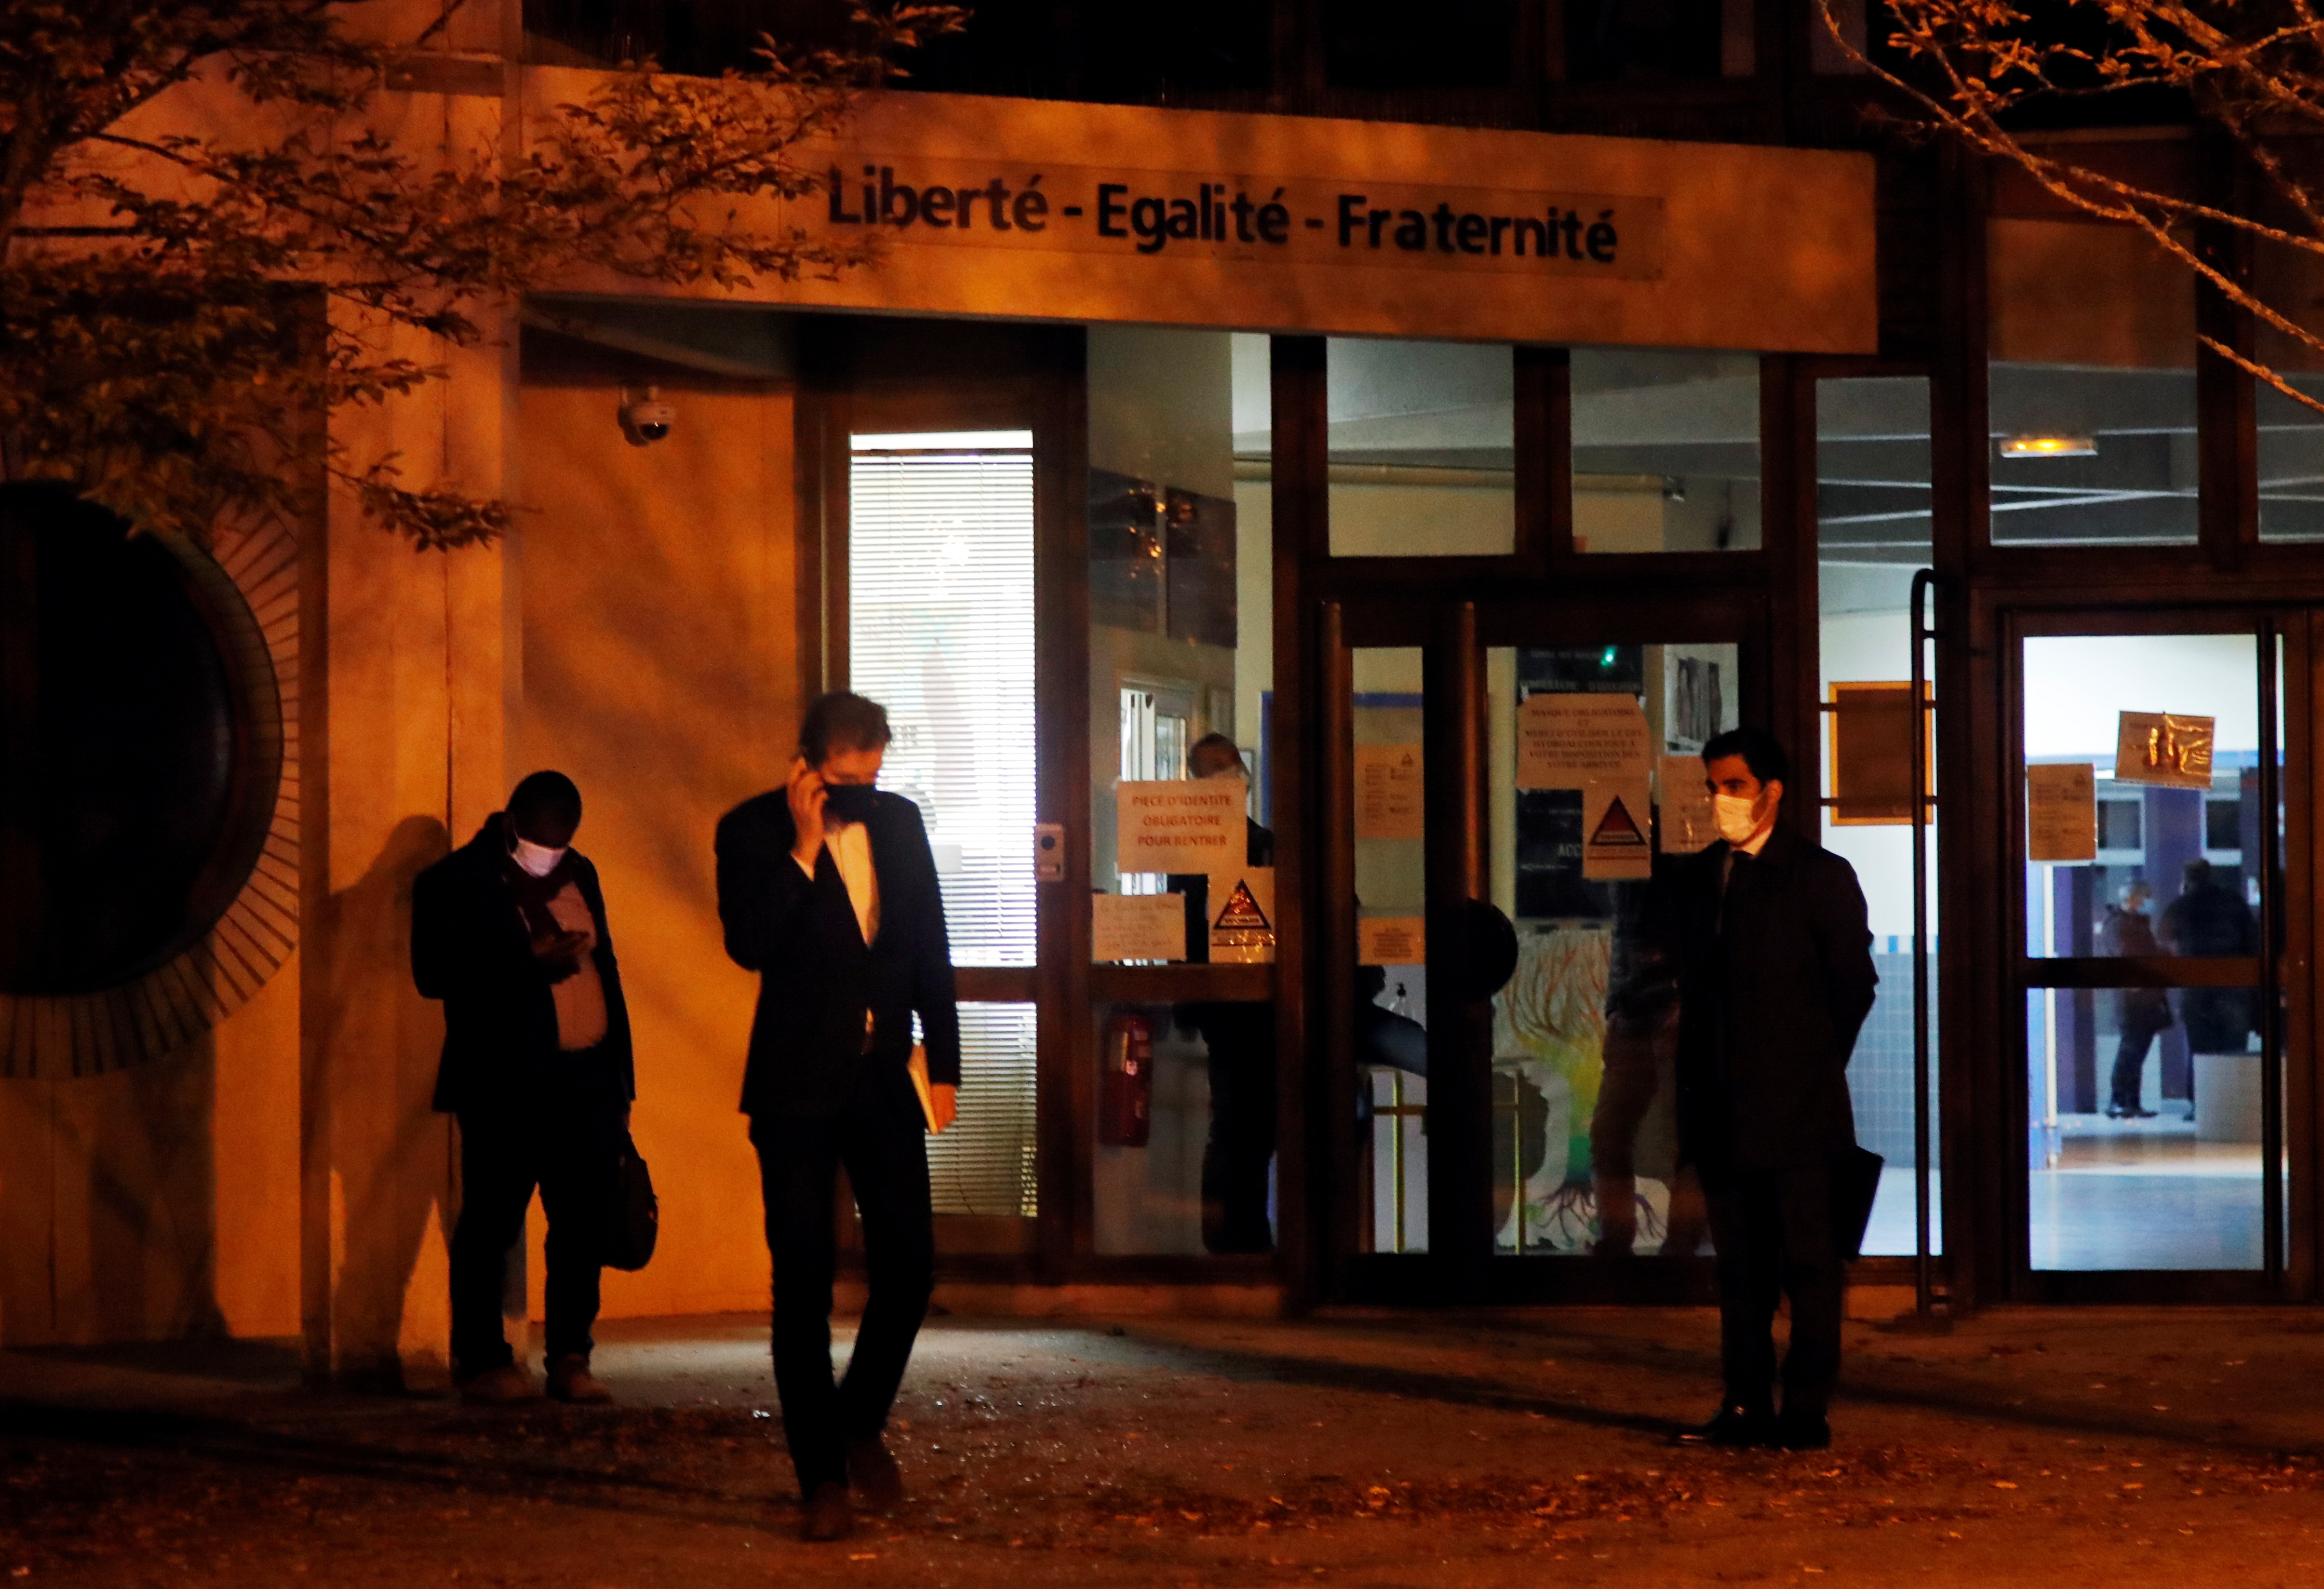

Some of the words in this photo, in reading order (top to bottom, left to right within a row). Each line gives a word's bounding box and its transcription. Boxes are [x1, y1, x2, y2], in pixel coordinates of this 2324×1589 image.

[829, 165, 1049, 232] Liberté
[1098, 183, 1291, 253] Egalité
[1338, 194, 1617, 263] Fraternité
[1132, 795, 1164, 807] PIECE
[1143, 815, 1221, 827] OBLIGATOIRE
[1138, 835, 1172, 847] POUR
[1174, 835, 1228, 847] RENTRER
